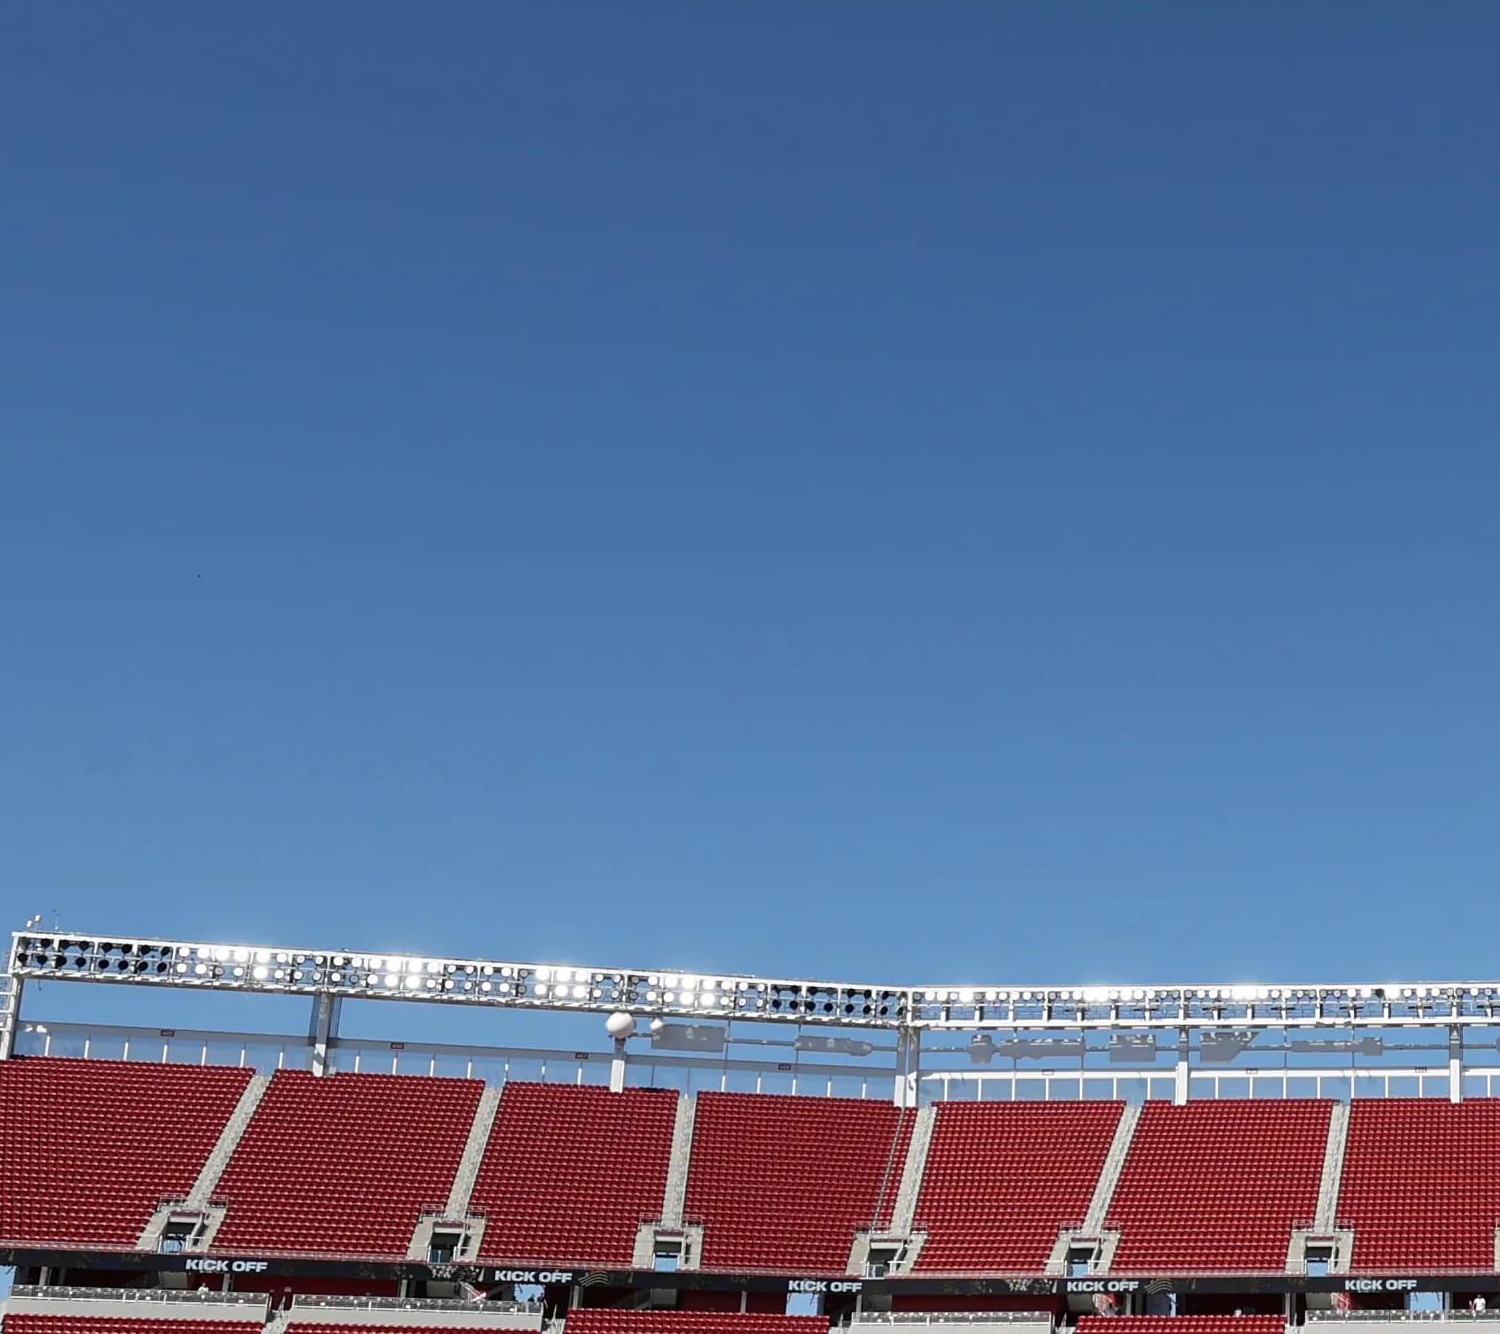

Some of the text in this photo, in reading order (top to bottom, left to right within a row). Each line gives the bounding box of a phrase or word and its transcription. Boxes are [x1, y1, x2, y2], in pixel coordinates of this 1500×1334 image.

[186, 1257, 268, 1273] KICK OFF
[495, 1270, 572, 1283] KICK OFF
[788, 1279, 861, 1293] KICK OFF
[1067, 1280, 1139, 1291] KICK OFF
[1345, 1278, 1419, 1293] KICK OFF
